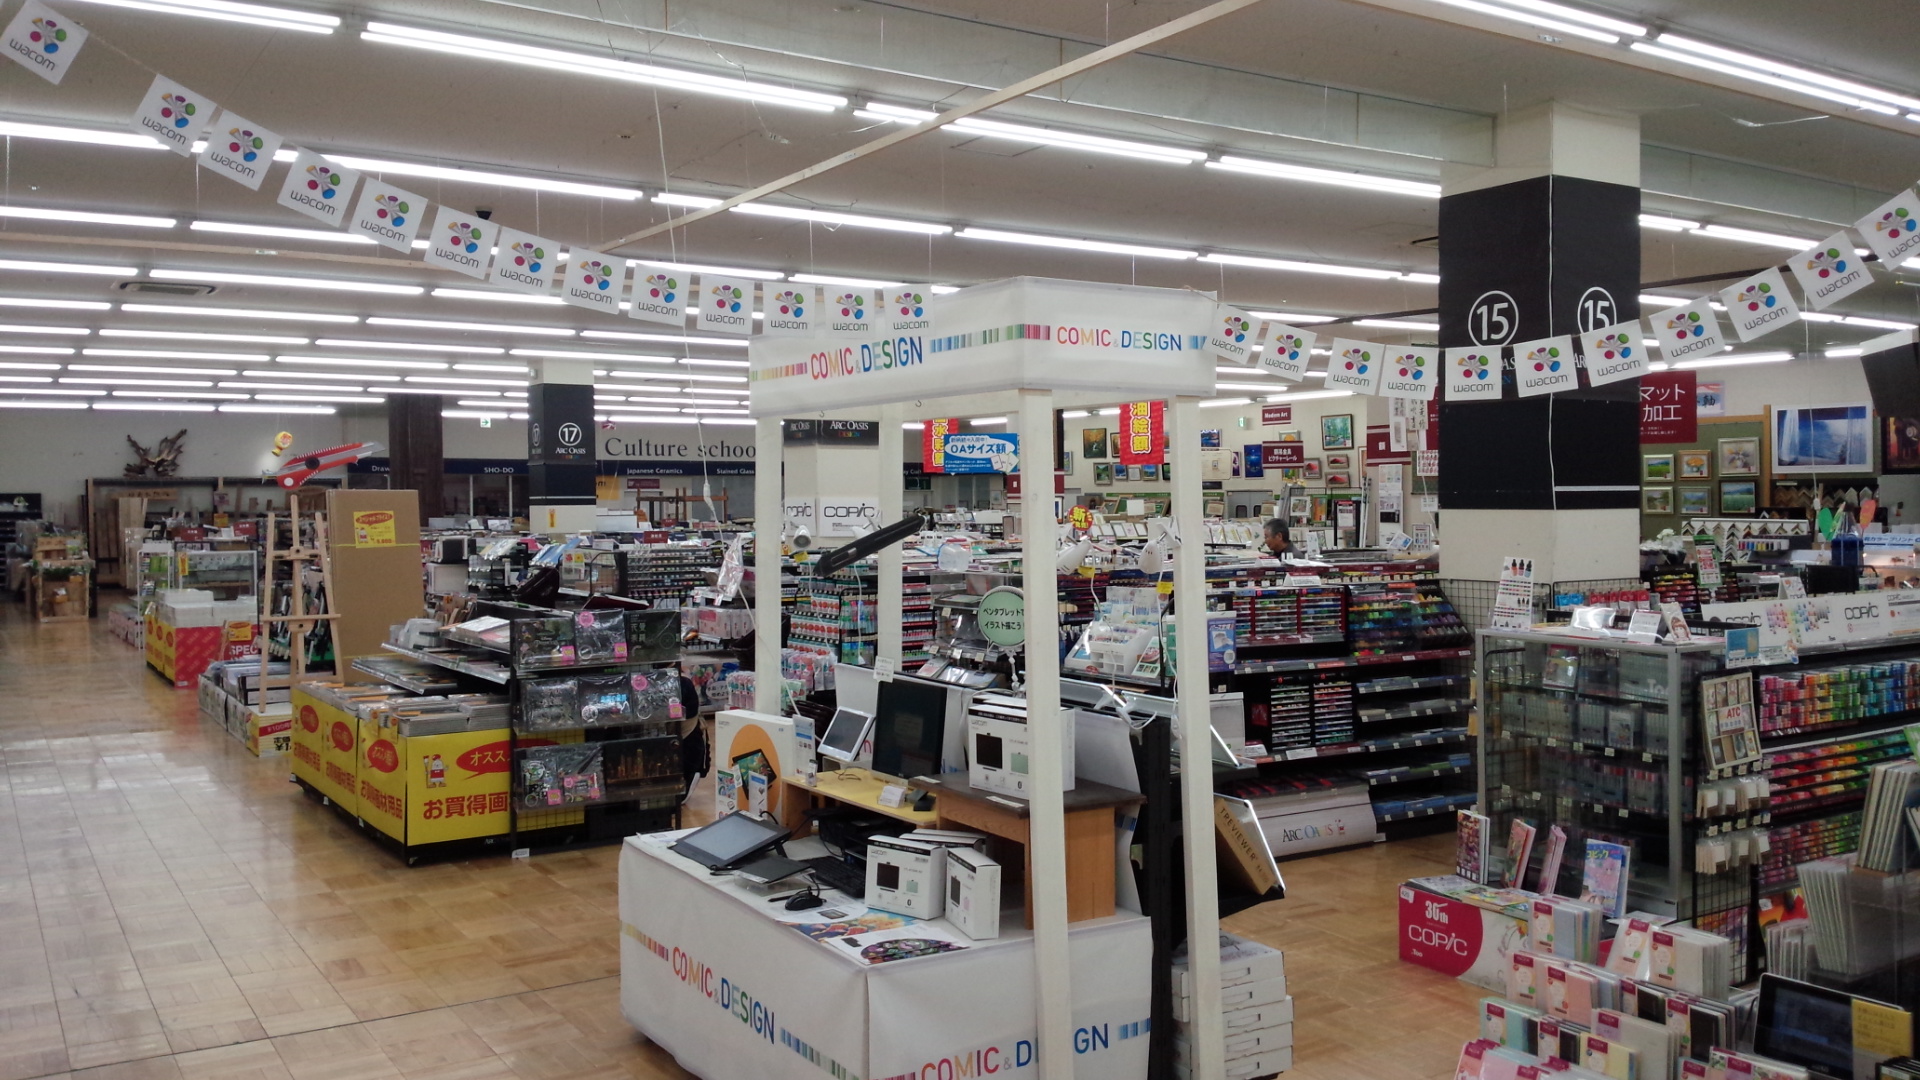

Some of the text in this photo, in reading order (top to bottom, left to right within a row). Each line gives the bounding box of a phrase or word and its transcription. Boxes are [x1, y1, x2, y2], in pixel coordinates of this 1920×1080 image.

[9, 38, 56, 71] wacom
[142, 116, 187, 145] wacom
[211, 152, 256, 178] wacom
[290, 190, 335, 215] wacom
[360, 220, 405, 243] wacom
[1888, 233, 1920, 259] waco
[435, 247, 480, 269] wacom
[500, 268, 543, 288] wacom
[1817, 270, 1860, 298] wacom
[571, 287, 613, 305] wacom
[638, 301, 678, 317] wacom
[1584, 300, 1610, 332] 15
[1744, 306, 1788, 330] wacom
[706, 313, 745, 326] wacom
[770, 320, 807, 330] wacom
[833, 323, 868, 331] wacom
[893, 321, 929, 330] wacom
[1476, 303, 1509, 340] 15
[1057, 326, 1111, 347] COMIC
[1121, 331, 1182, 351] DESIGN
[1212, 338, 1244, 356] wacom
[1671, 336, 1715, 358] wacom
[811, 347, 854, 380] COMIC
[861, 336, 923, 372] DESIGN
[1265, 358, 1299, 374] wacom
[1597, 360, 1641, 377] wacom
[1333, 375, 1370, 388] wacom
[1387, 382, 1426, 393] wacom
[1453, 383, 1493, 393] wacom
[1526, 375, 1568, 388] wacom
[1640, 384, 1685, 401] マット
[1643, 404, 1682, 422] 加工
[562, 427, 578, 442] 17
[830, 421, 869, 430] ARC OASIS
[605, 437, 756, 458] Culture schoo
[950, 443, 1007, 454] OAサイズ額
[229, 645, 258, 655] SPEC
[1726, 707, 1741, 719] ATC
[470, 750, 510, 766] オスス
[423, 791, 509, 820] お買得画
[1219, 807, 1256, 863] TREVIEWER
[1282, 828, 1303, 843] ARC
[1425, 900, 1449, 925] 30th
[673, 946, 713, 998] COMIC
[721, 977, 775, 1045] DESIGN
[921, 1047, 1000, 1080] COMIC
[1016, 1023, 1109, 1068] DGN
